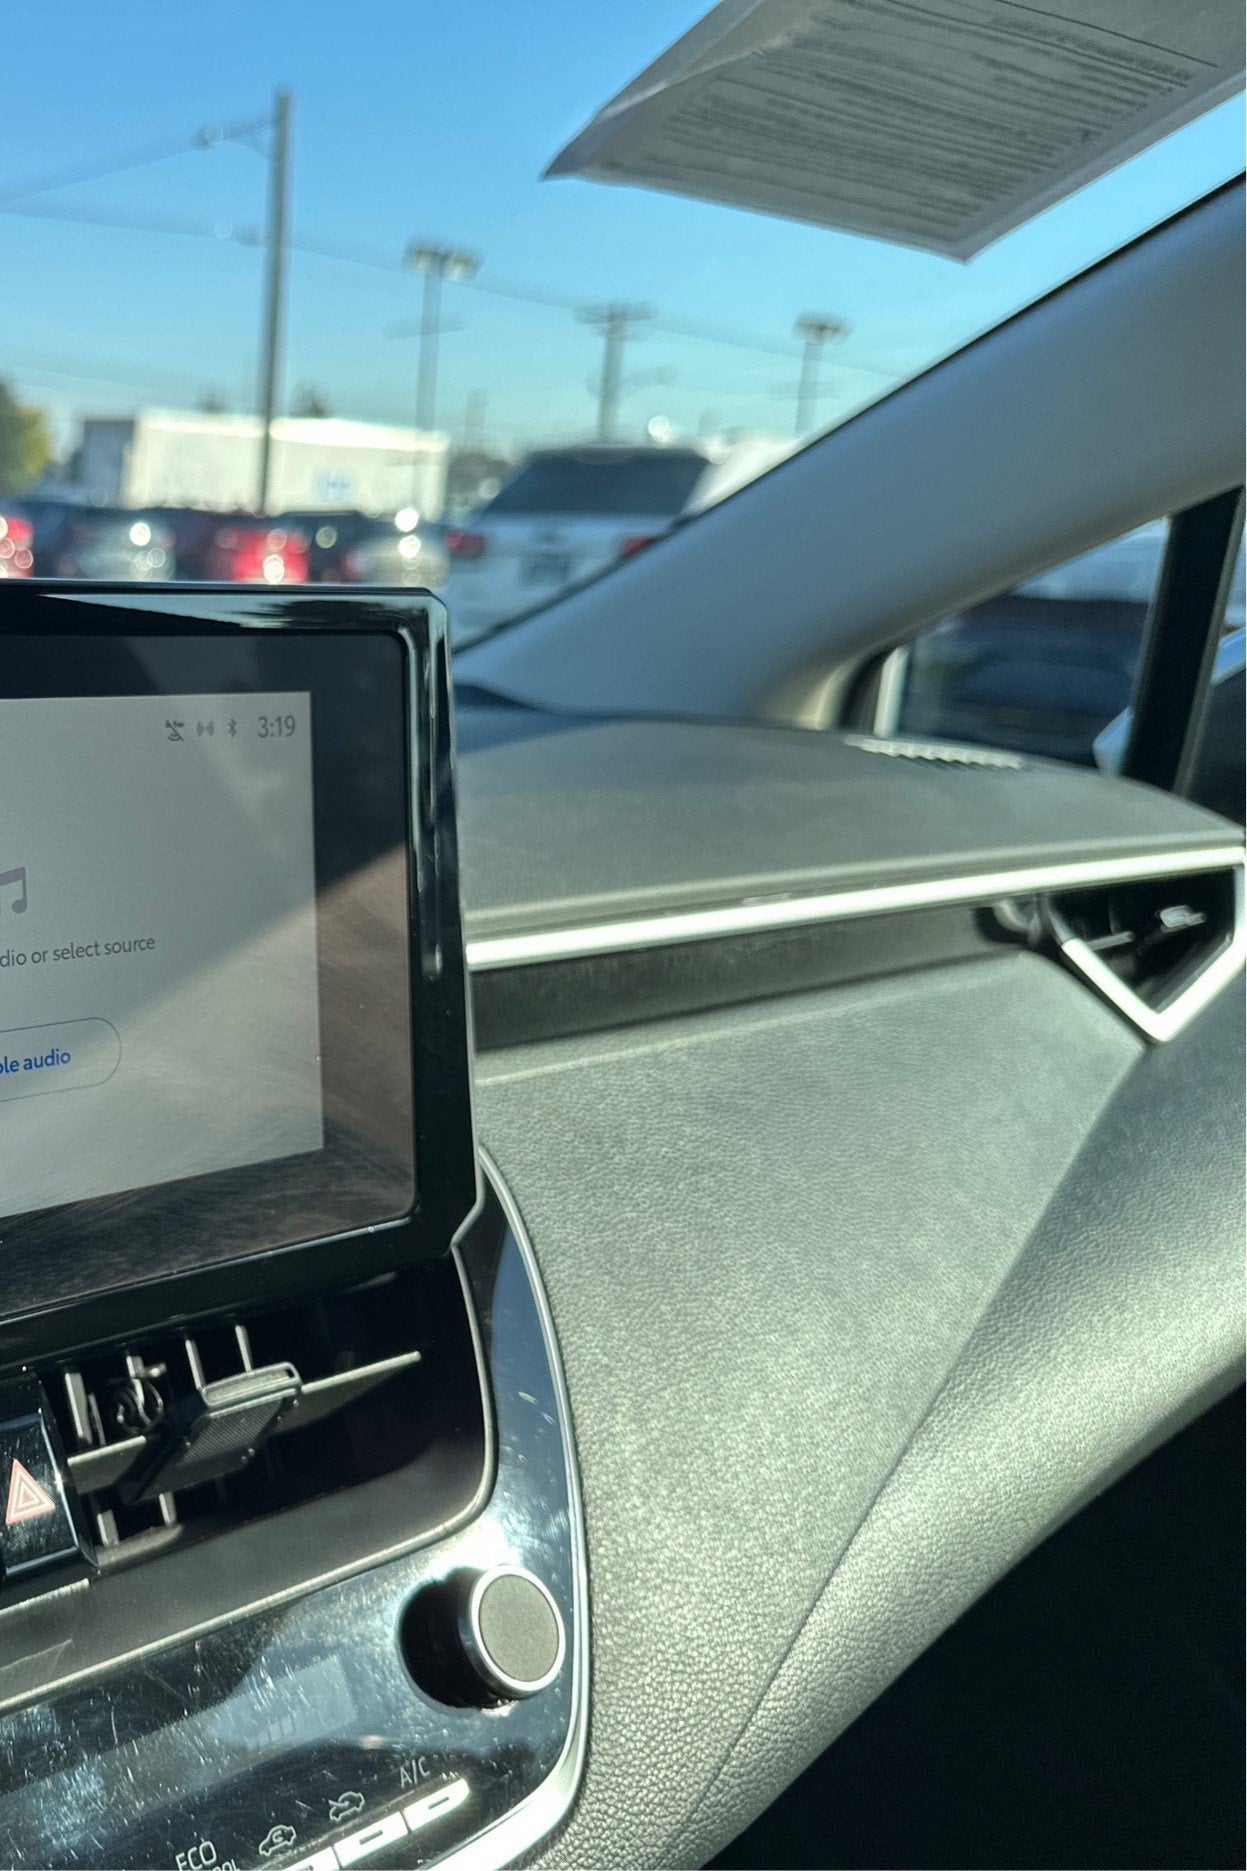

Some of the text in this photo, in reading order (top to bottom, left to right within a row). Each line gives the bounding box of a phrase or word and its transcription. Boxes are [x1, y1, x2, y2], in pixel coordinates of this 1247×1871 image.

[257, 715, 296, 739] 3:19
[31, 949, 49, 964] or
[53, 940, 101, 962] select
[104, 937, 157, 956] source
[23, 1048, 71, 1070] audio
[400, 1756, 431, 1789] A/C
[175, 1841, 217, 1871] ECO
